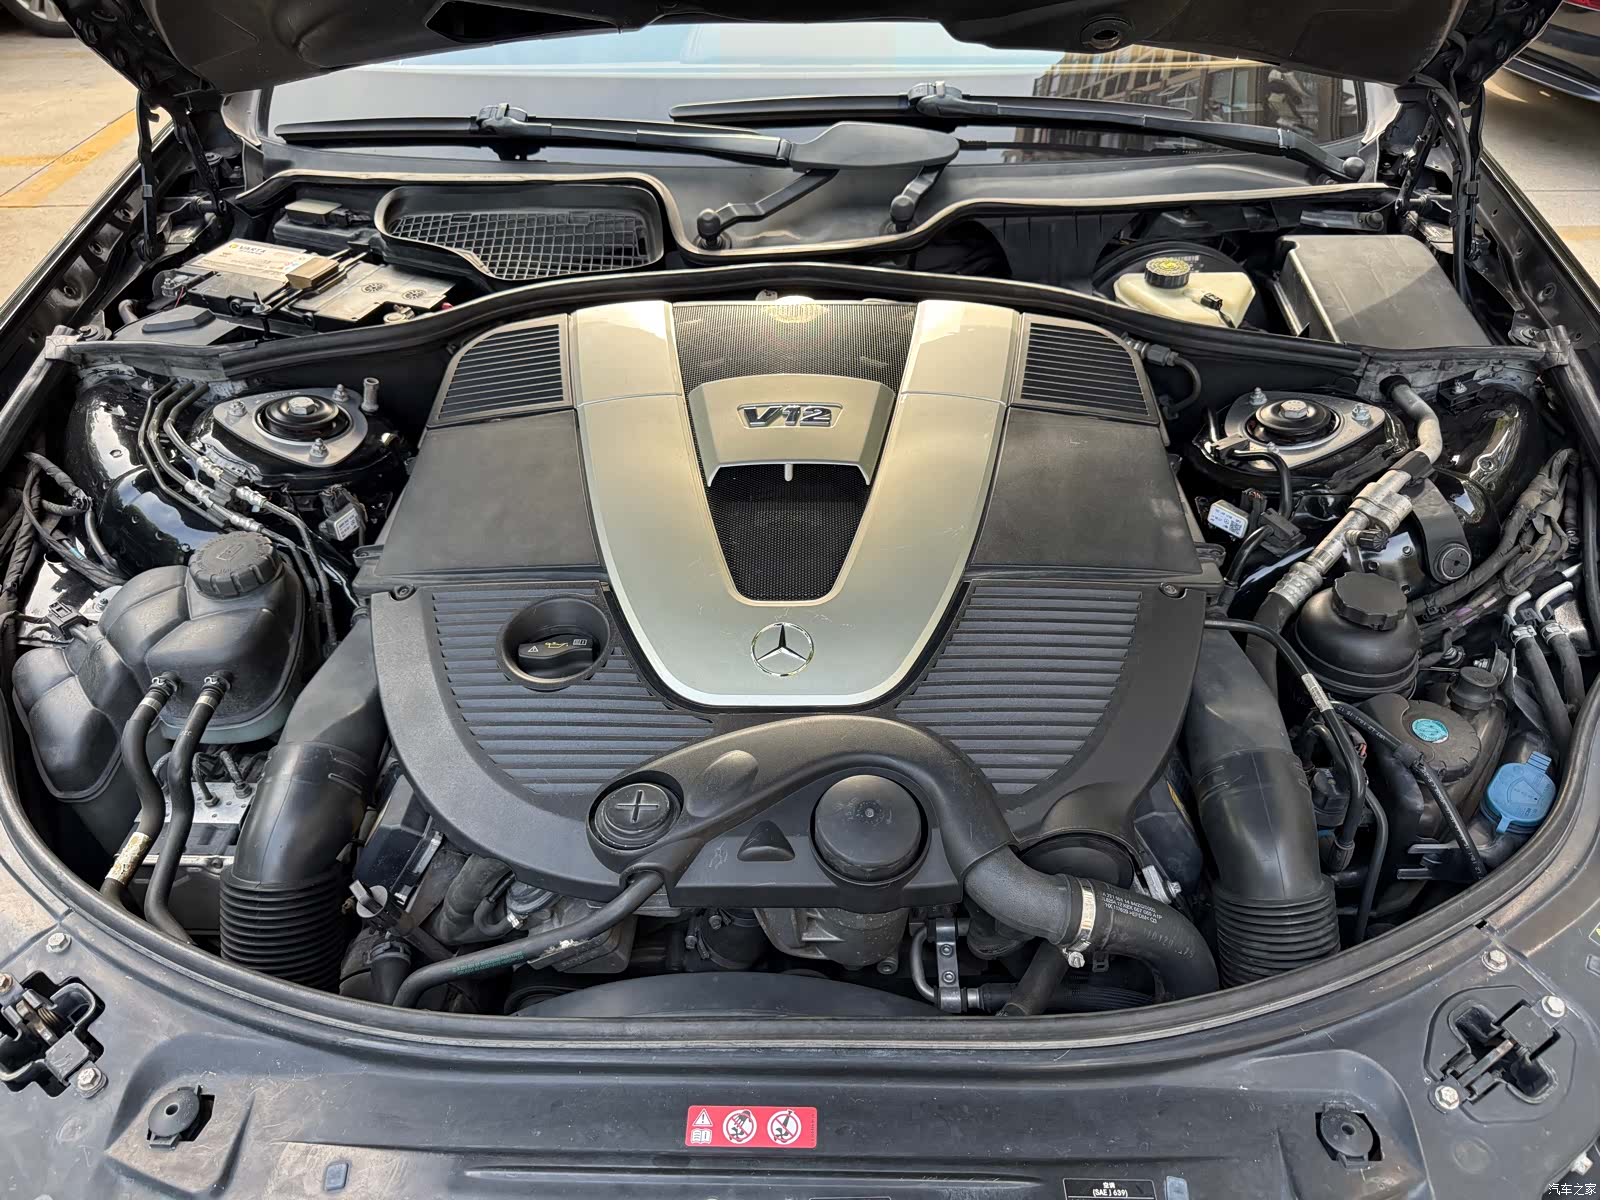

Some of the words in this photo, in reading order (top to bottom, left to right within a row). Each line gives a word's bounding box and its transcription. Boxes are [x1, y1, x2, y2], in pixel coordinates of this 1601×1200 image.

[743, 404, 832, 427] V12
[1092, 1189, 1108, 1197] (SAE
[1113, 1189, 1128, 1198] 639)
